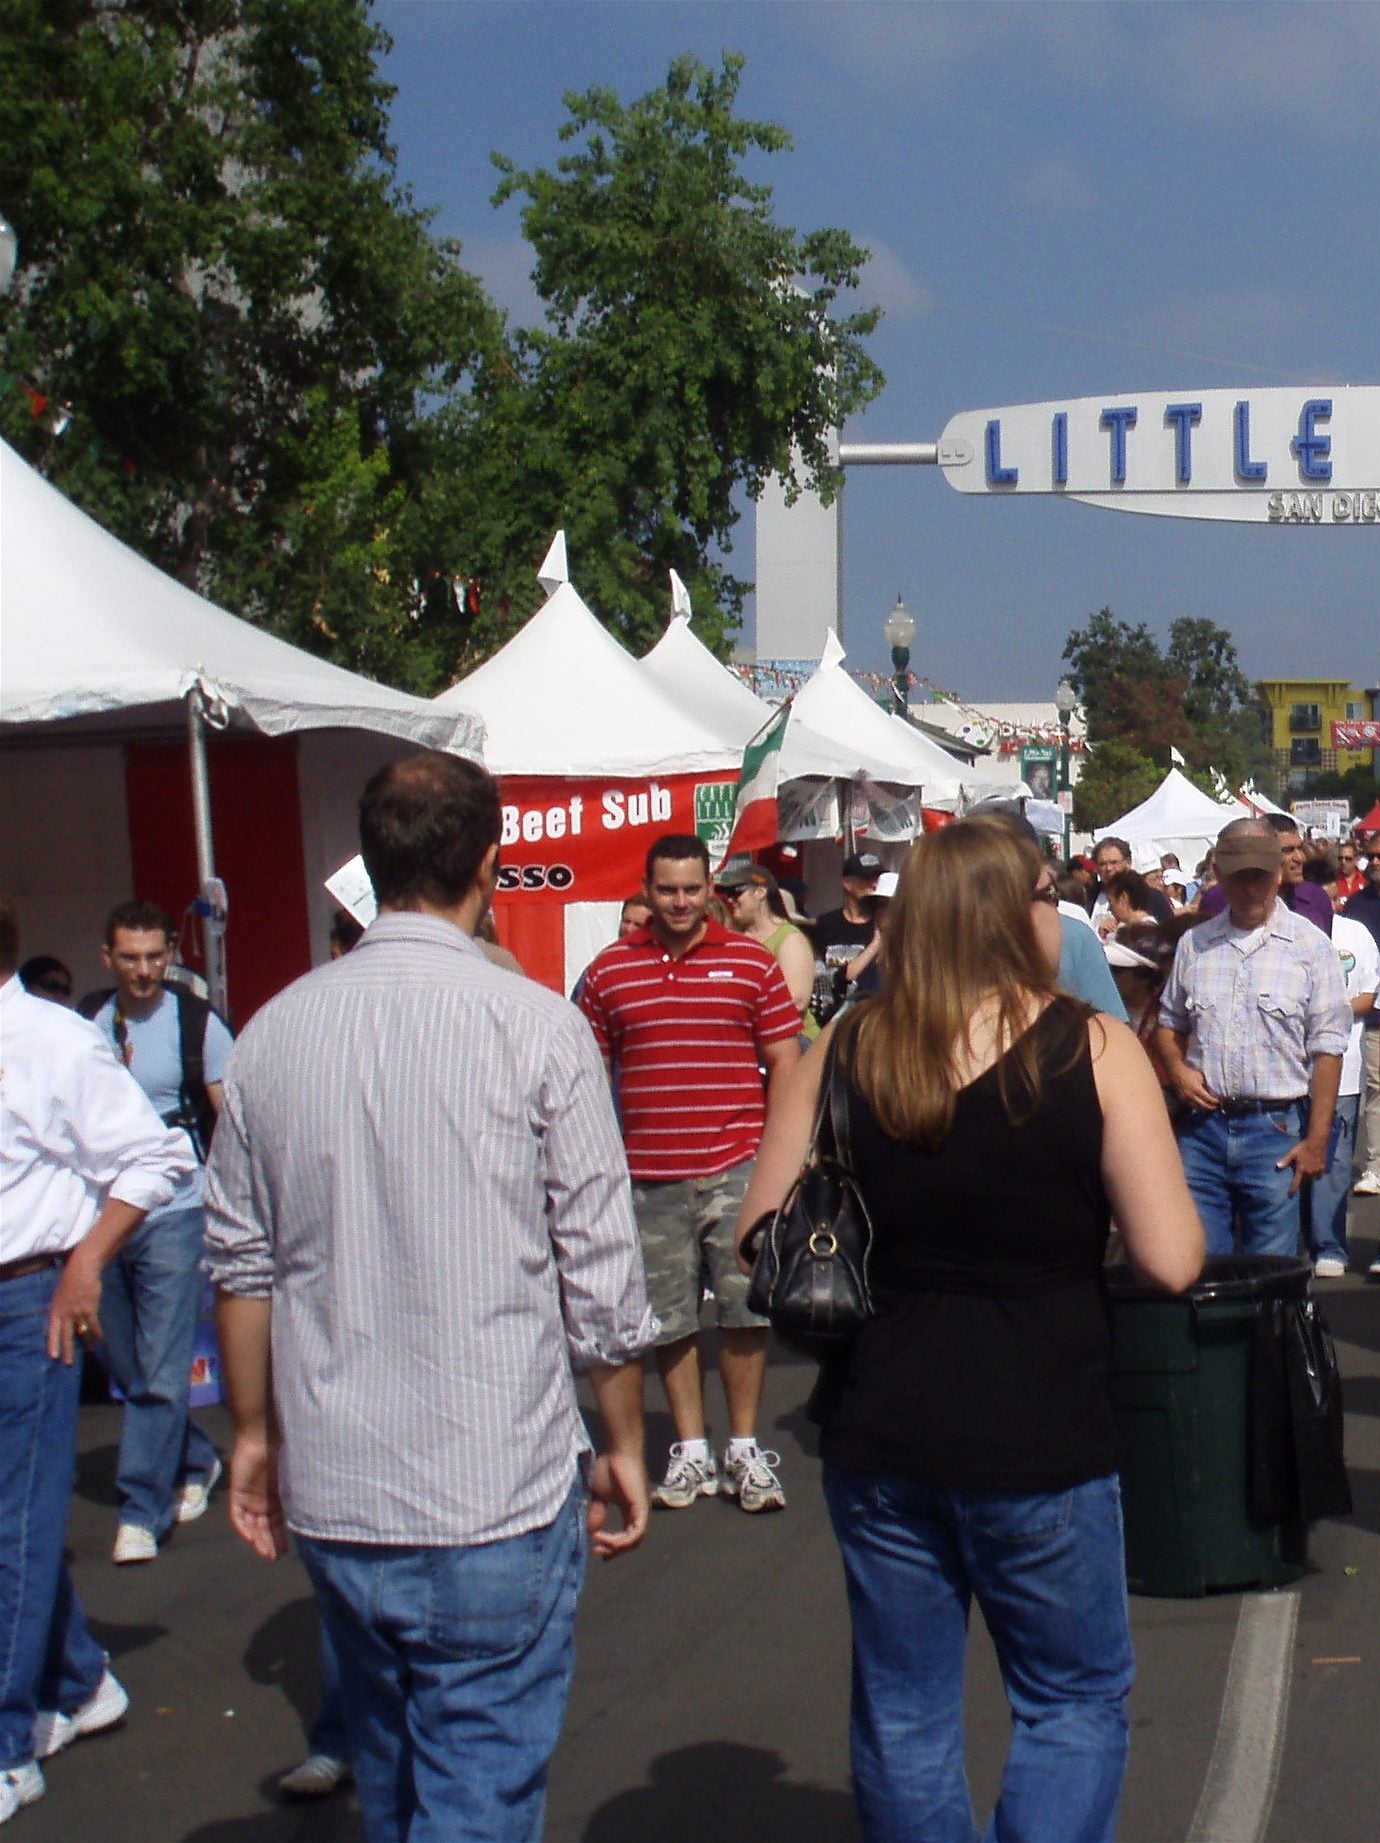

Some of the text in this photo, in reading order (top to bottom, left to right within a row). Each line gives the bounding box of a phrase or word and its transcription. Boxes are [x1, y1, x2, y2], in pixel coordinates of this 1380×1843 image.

[985, 398, 1333, 485] LITTLE
[1268, 491, 1323, 521] SAN
[500, 782, 672, 847] Beef Sub
